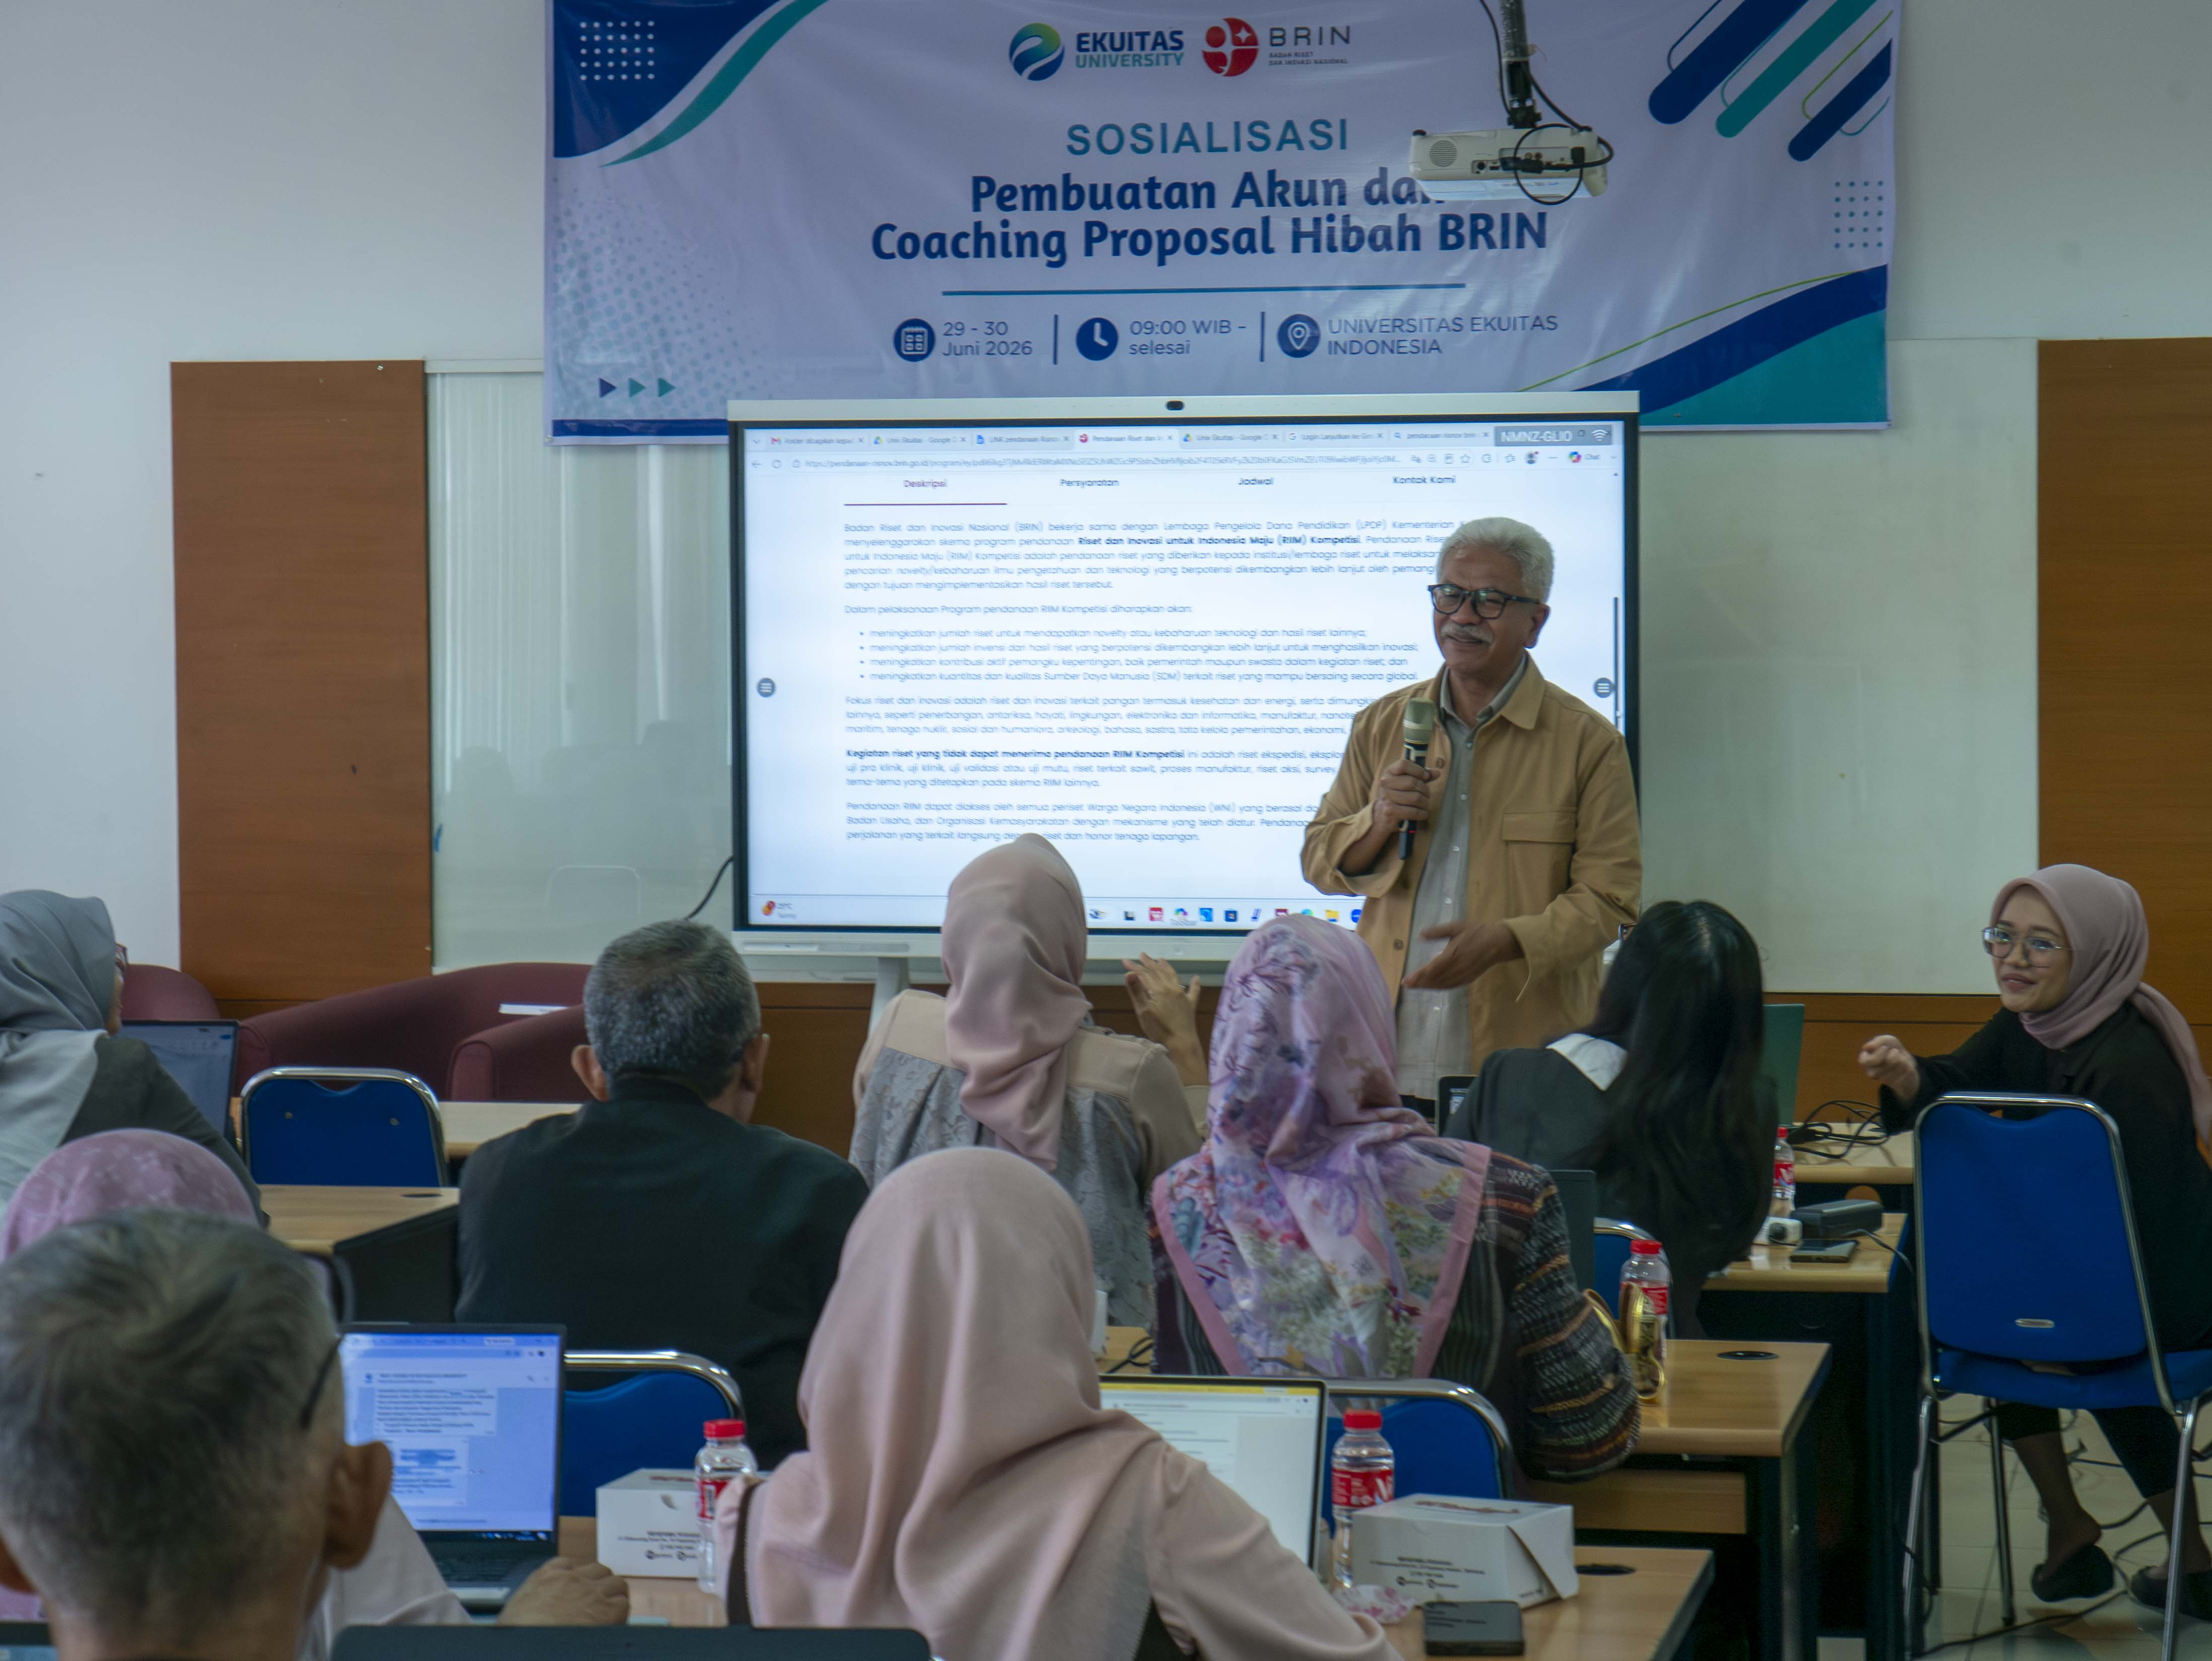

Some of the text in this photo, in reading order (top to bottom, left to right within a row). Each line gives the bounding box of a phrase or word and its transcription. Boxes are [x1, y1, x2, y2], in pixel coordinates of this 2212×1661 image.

[1076, 30, 1184, 52] EKUITAS
[1269, 25, 1350, 46] BRIN
[1075, 52, 1184, 68] UNIVERSITY
[1065, 118, 1347, 156] SOSIALISASI
[971, 166, 1445, 212] Pembuatan Akun da
[872, 211, 1547, 269] Coaching Proposal Hibah BRIN
[942, 322, 965, 336] 29
[984, 321, 1008, 336] 30
[1129, 320, 1187, 335] 09:00
[1192, 320, 1232, 334] WIB
[1328, 315, 1559, 334] UNIVERSITAS EKUITAS
[942, 340, 1033, 356] Juni 2026
[1129, 340, 1190, 355] selesai
[1328, 339, 1443, 355] INDONESIA
[903, 479, 948, 489] Deskripsi
[1060, 479, 1120, 488] Persyaratan
[1238, 477, 1274, 486] Jadwal
[1392, 475, 1456, 484] Kontak Kami
[1077, 537, 1102, 545] Riset
[1104, 537, 1125, 545] dan
[1127, 536, 1163, 544] Inovasi
[1165, 536, 1195, 544] untuk
[1197, 536, 1247, 544] Indonesia
[1249, 536, 1274, 546] Maju
[846, 750, 890, 760] Kegiatan
[891, 750, 914, 758] riset
[915, 752, 941, 760] yang
[942, 750, 968, 758] tidak
[969, 750, 999, 760] dapat
[1001, 750, 1052, 758] menerima
[1053, 750, 1111, 760] pendanaan
[1135, 750, 1185, 760] Kompetisi
